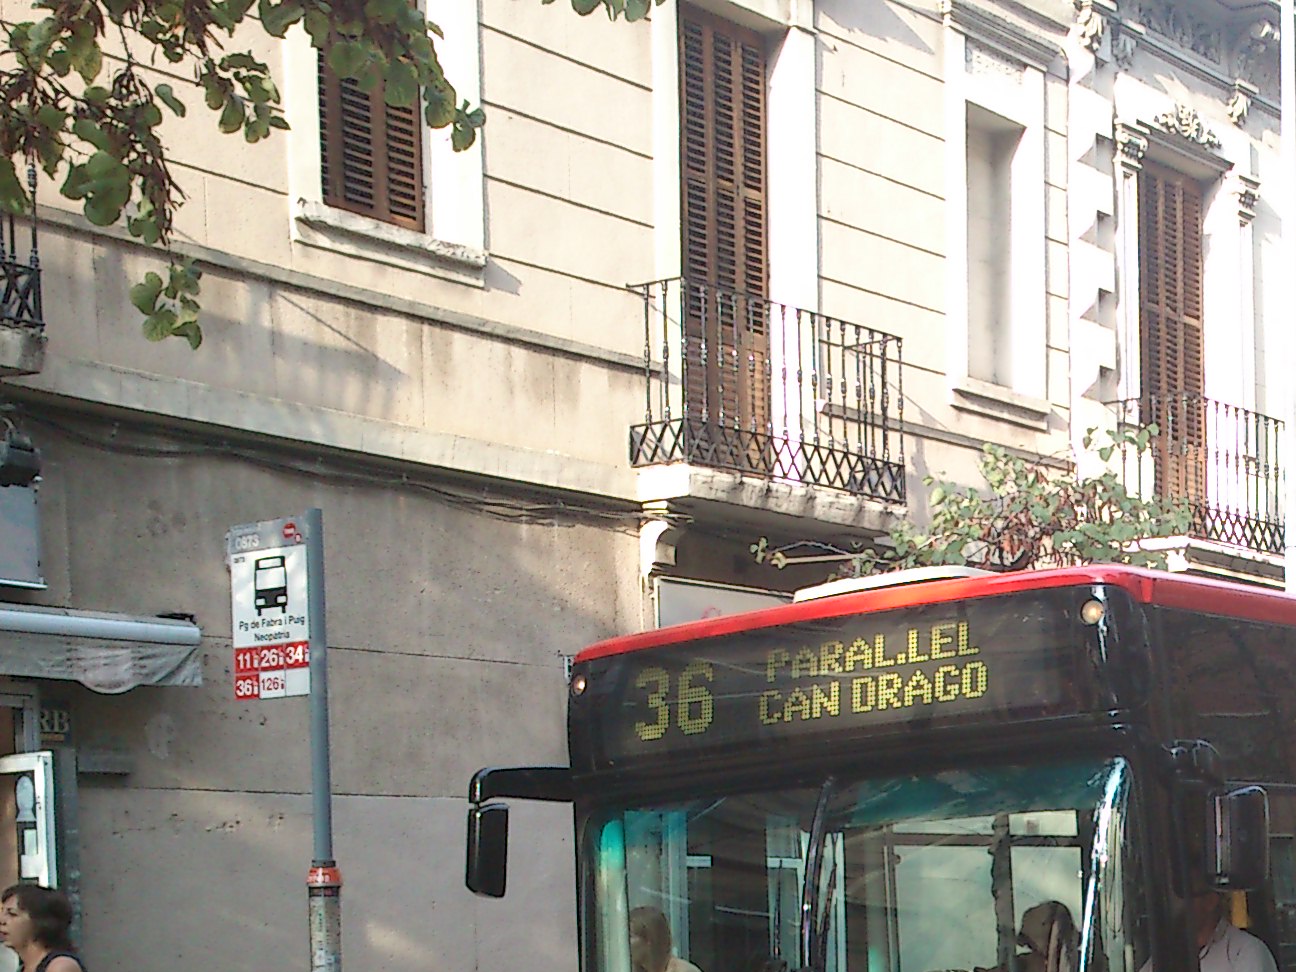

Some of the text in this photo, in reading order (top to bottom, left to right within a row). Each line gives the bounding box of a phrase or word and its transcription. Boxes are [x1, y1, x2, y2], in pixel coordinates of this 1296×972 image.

[239, 620, 249, 632] Pg
[261, 617, 283, 628] Fabra
[237, 645, 303, 669] 11 26 34
[236, 676, 280, 697] 36 126
[635, 662, 714, 741] 36
[758, 682, 840, 725] CAN
